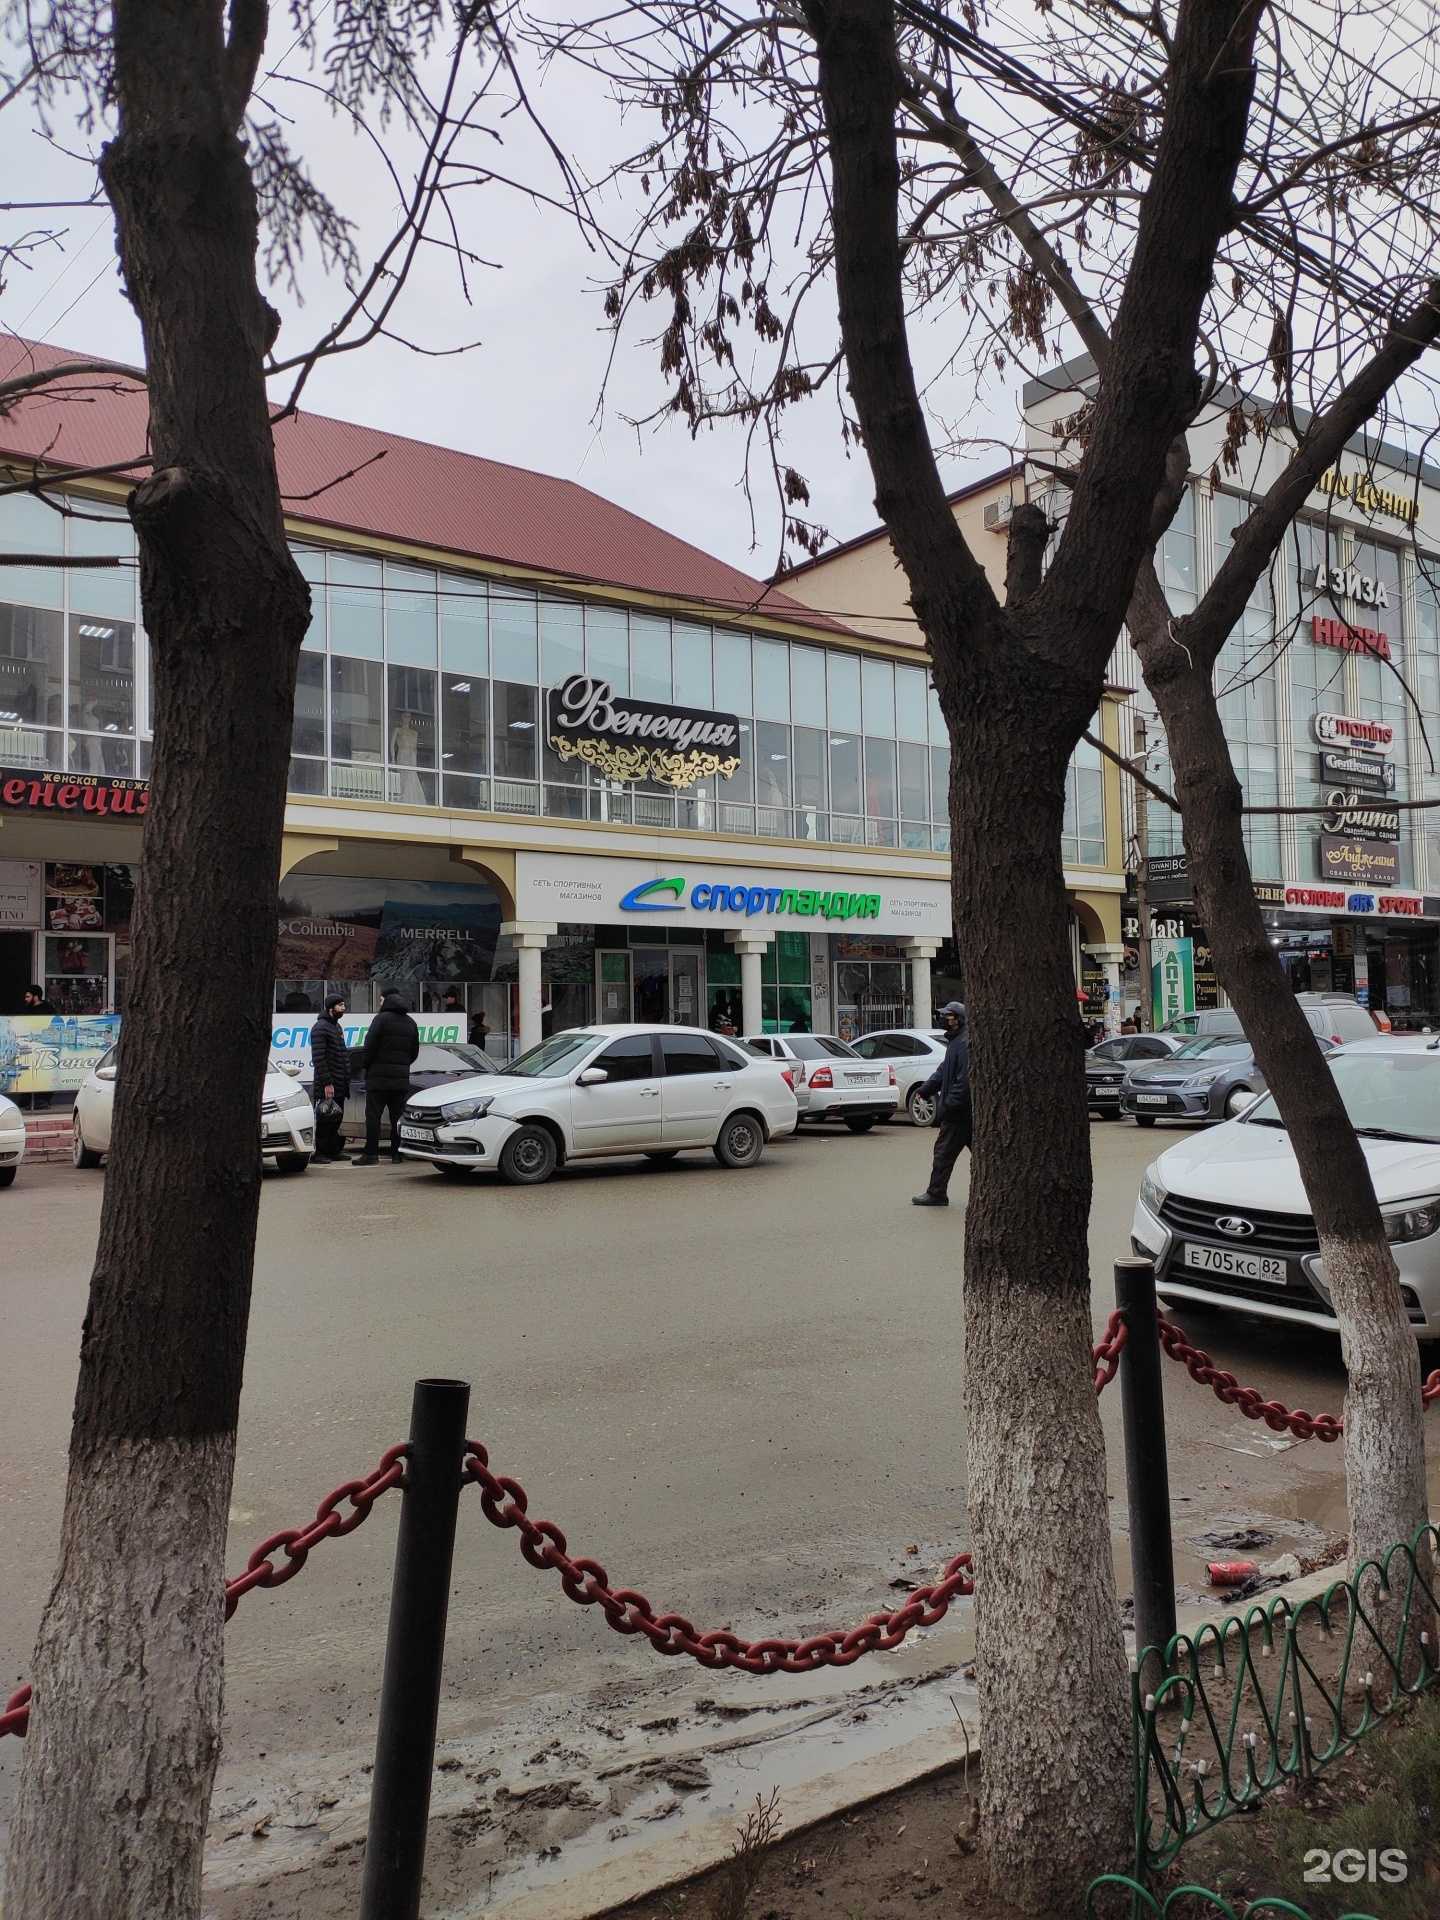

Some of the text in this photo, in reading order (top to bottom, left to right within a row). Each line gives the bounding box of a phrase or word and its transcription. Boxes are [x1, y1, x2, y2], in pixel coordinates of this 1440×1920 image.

[1315, 563, 1390, 609] АЗИЗА
[557, 674, 738, 751] Венеция
[42, 772, 98, 786] женская
[532, 879, 603, 891] СЕТЬ СПОРТИВНЫХ
[559, 892, 602, 901] МАГАЗИНОВ
[289, 919, 355, 938] Columbia
[400, 927, 475, 942] MERRELL
[1262, 1259, 1280, 1275] 82
